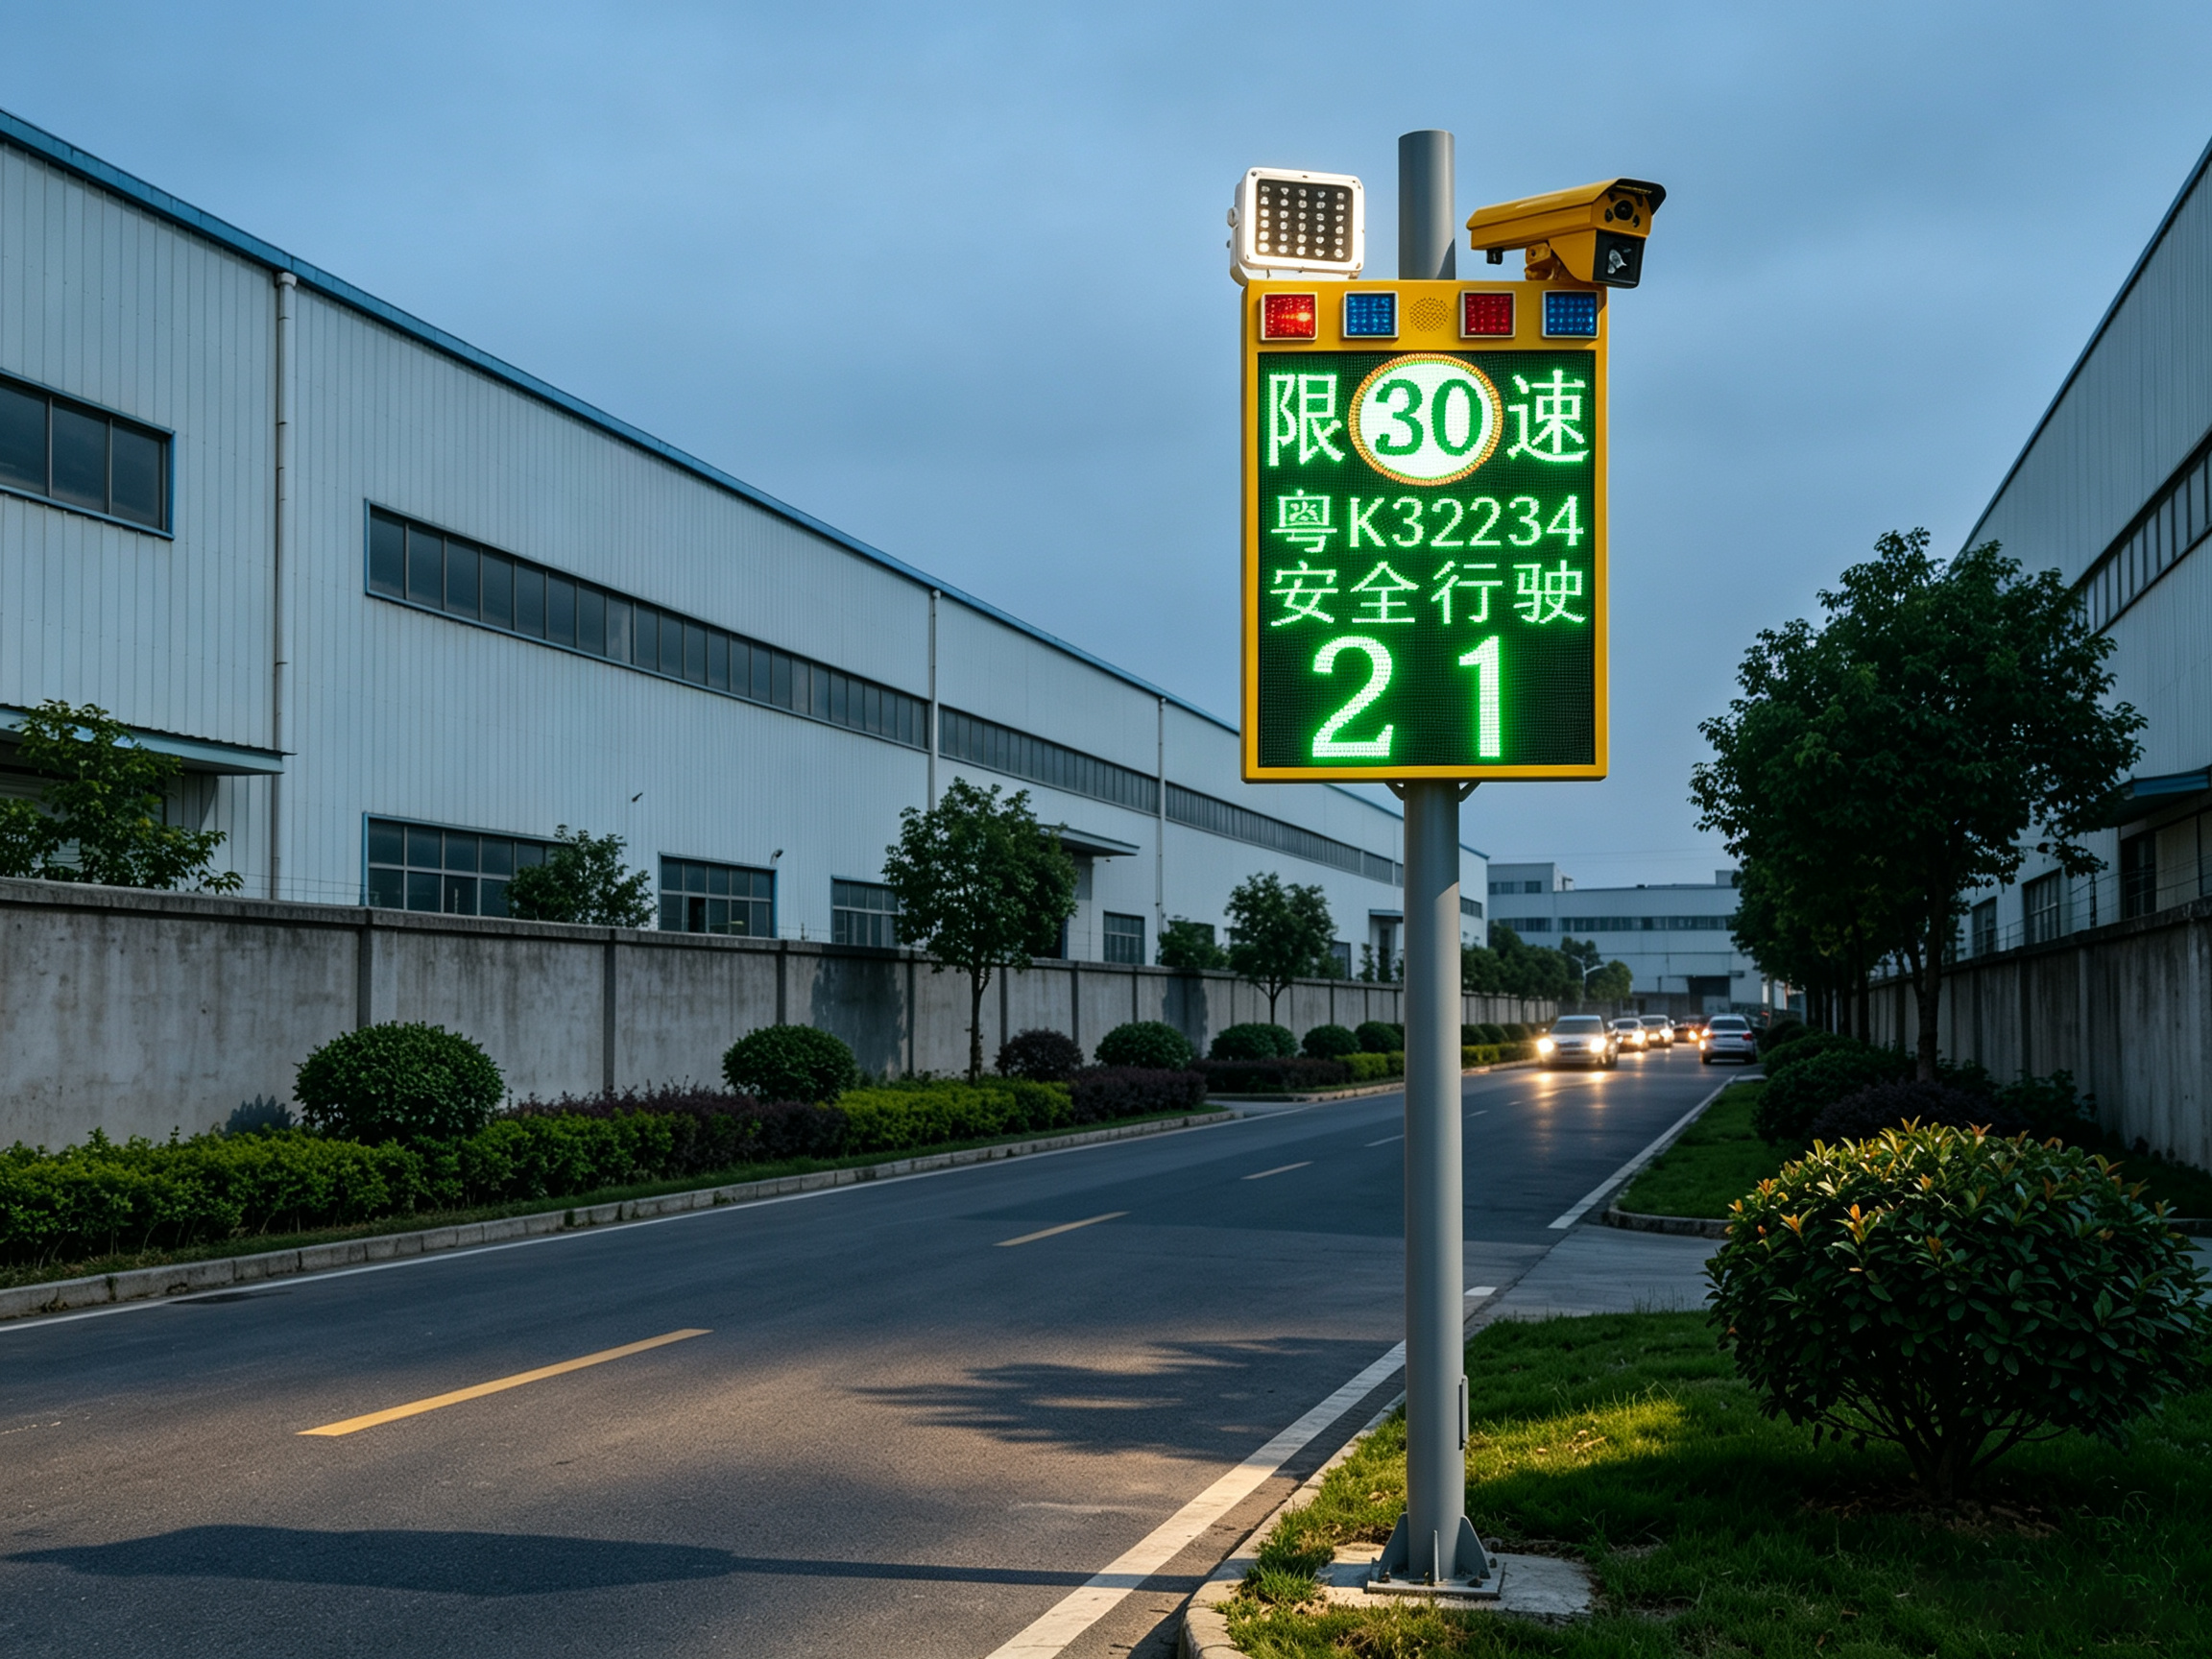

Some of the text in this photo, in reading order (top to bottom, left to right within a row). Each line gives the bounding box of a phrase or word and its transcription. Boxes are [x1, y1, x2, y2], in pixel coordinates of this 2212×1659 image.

[1375, 378, 1482, 456] 30
[1270, 560, 1587, 627] 安全行驶
